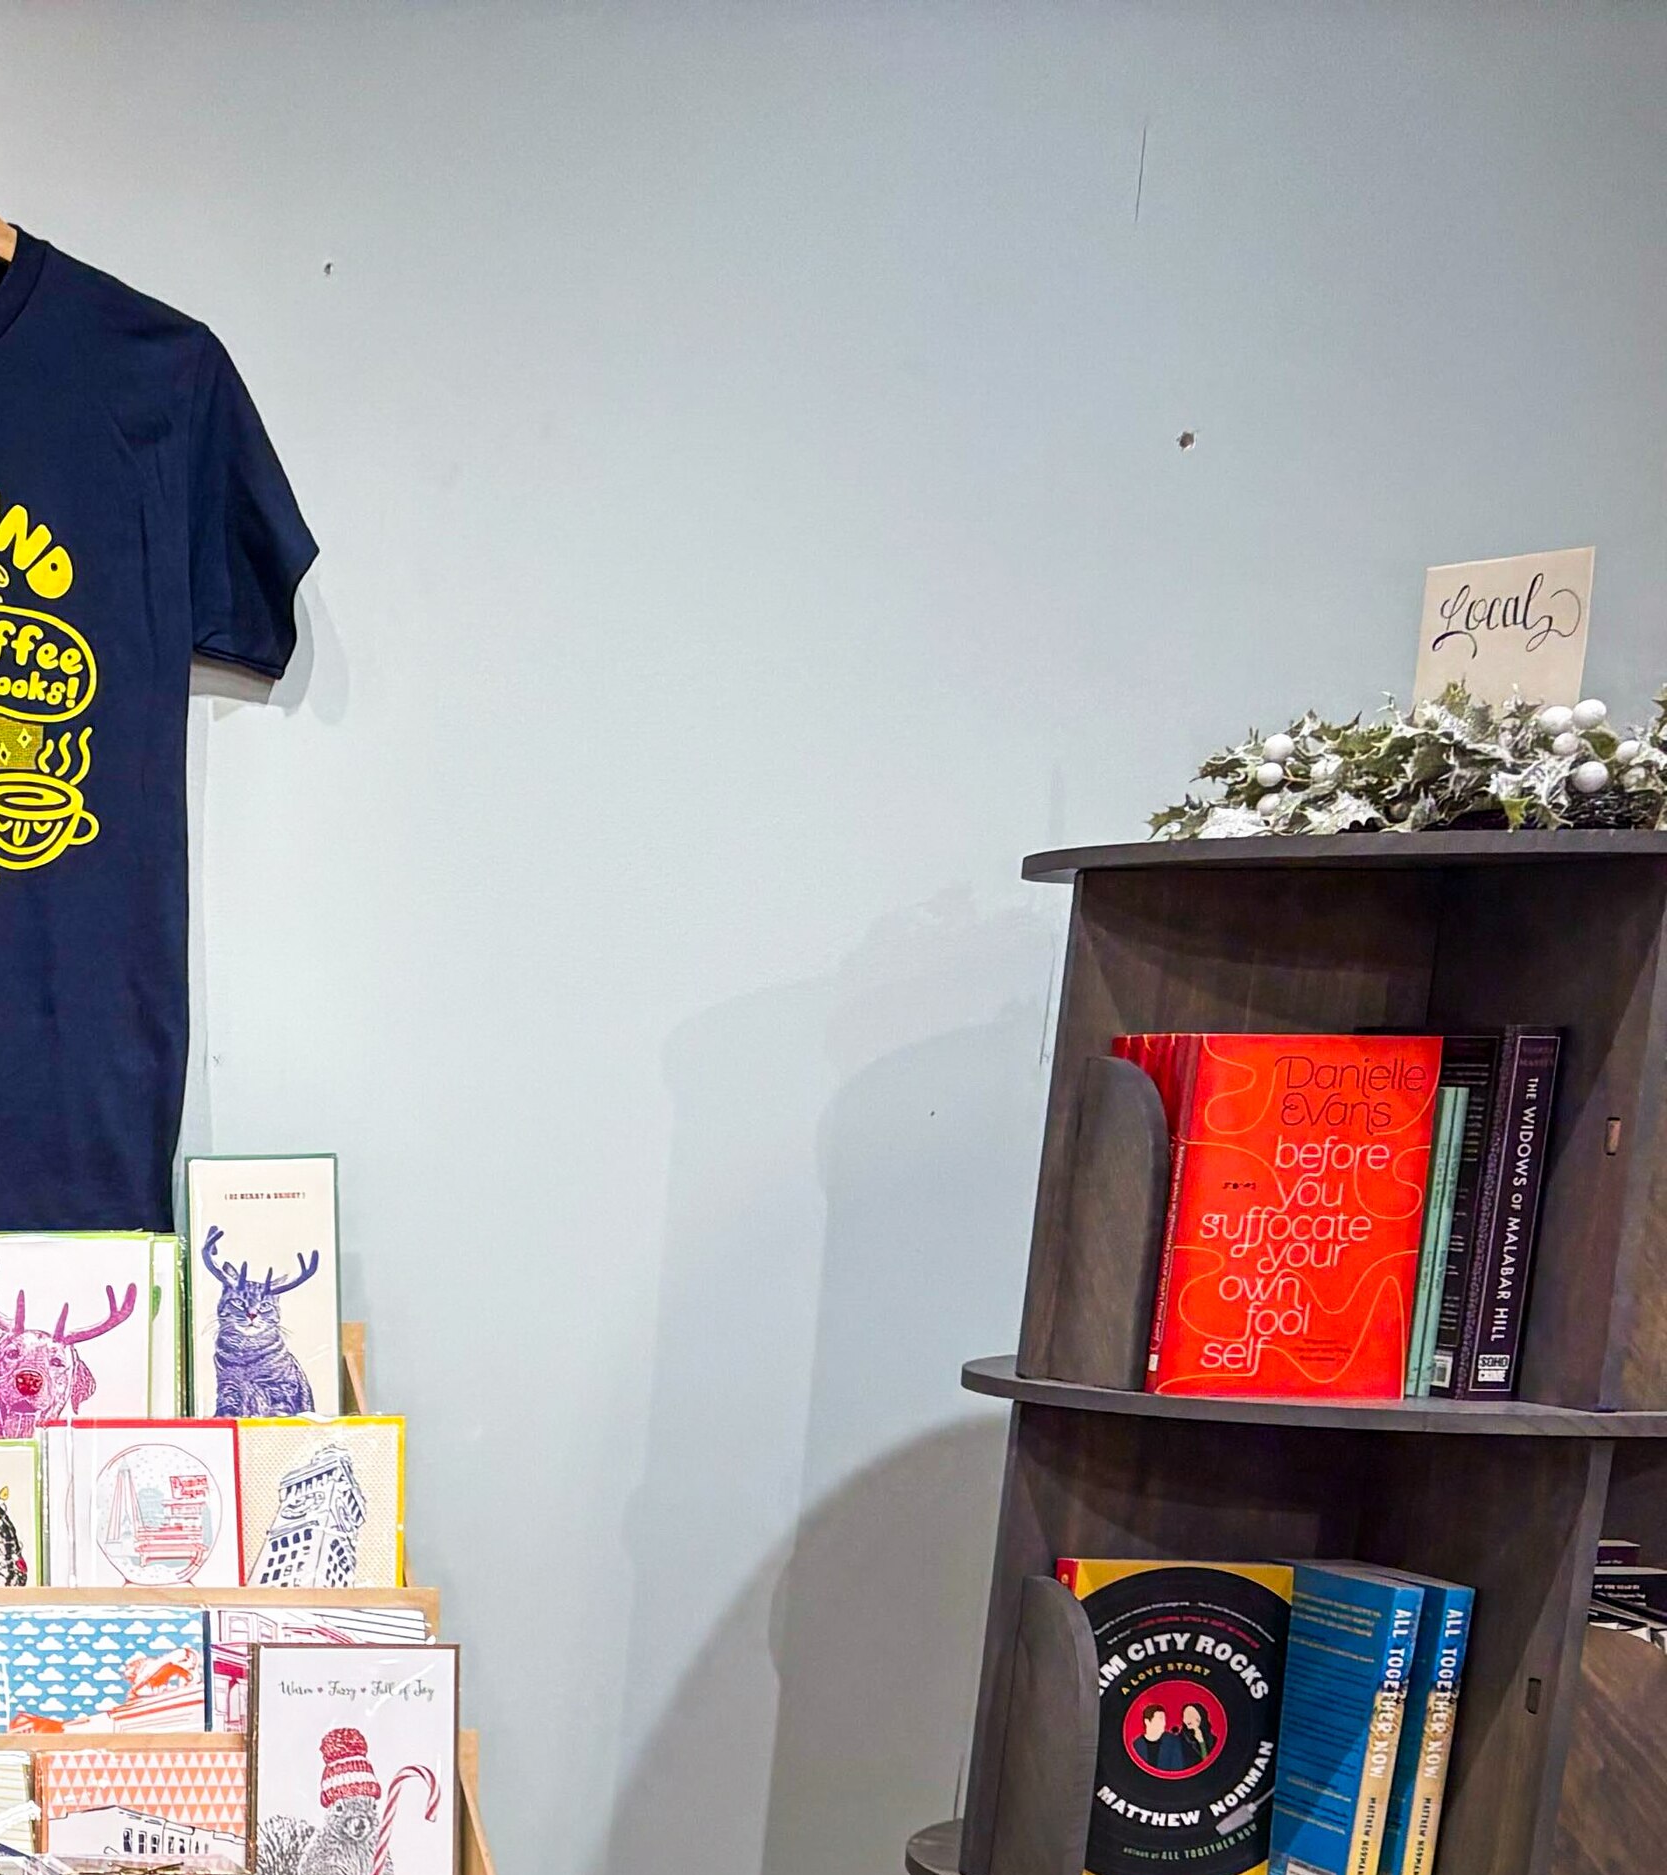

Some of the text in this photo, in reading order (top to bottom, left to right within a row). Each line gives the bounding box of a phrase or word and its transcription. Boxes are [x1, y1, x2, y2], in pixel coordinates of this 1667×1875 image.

[1274, 1135, 1390, 1178] before
[1490, 1077, 1539, 1342] THE WIDOWS OF MALABAR HILL
[1121, 1663, 1211, 1695] A LOVE STORY
[1127, 1633, 1268, 1699] CITY ROCKS
[1369, 1607, 1413, 1781] ALL TOGETHER NOW
[1424, 1607, 1464, 1781] ALL TOGETHER NOW
[1096, 1740, 1275, 1828] MATTHEW NORMAN
